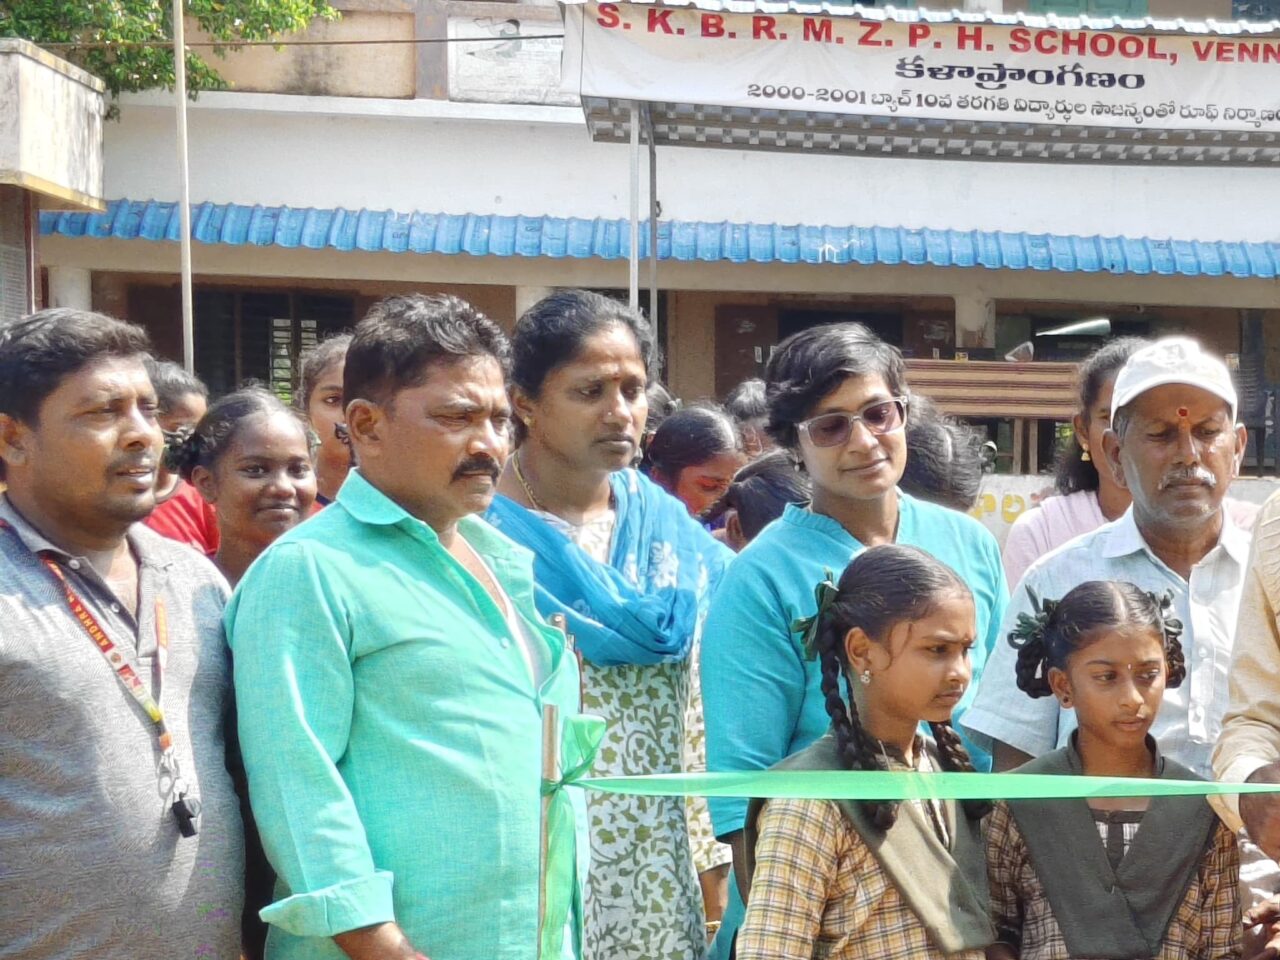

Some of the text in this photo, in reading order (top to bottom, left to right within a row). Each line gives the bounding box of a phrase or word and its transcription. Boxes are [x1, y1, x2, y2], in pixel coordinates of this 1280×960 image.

[597, 3, 631, 30] S.
[647, 9, 685, 36] K.
[700, 13, 736, 39] B.
[752, 15, 788, 40] R.
[802, 18, 844, 45] M.
[858, 21, 893, 47] Z.
[908, 23, 942, 49] P.
[957, 26, 994, 51] H.
[1009, 28, 1178, 65] SCHOOL,
[747, 83, 867, 105] 2000-2001
